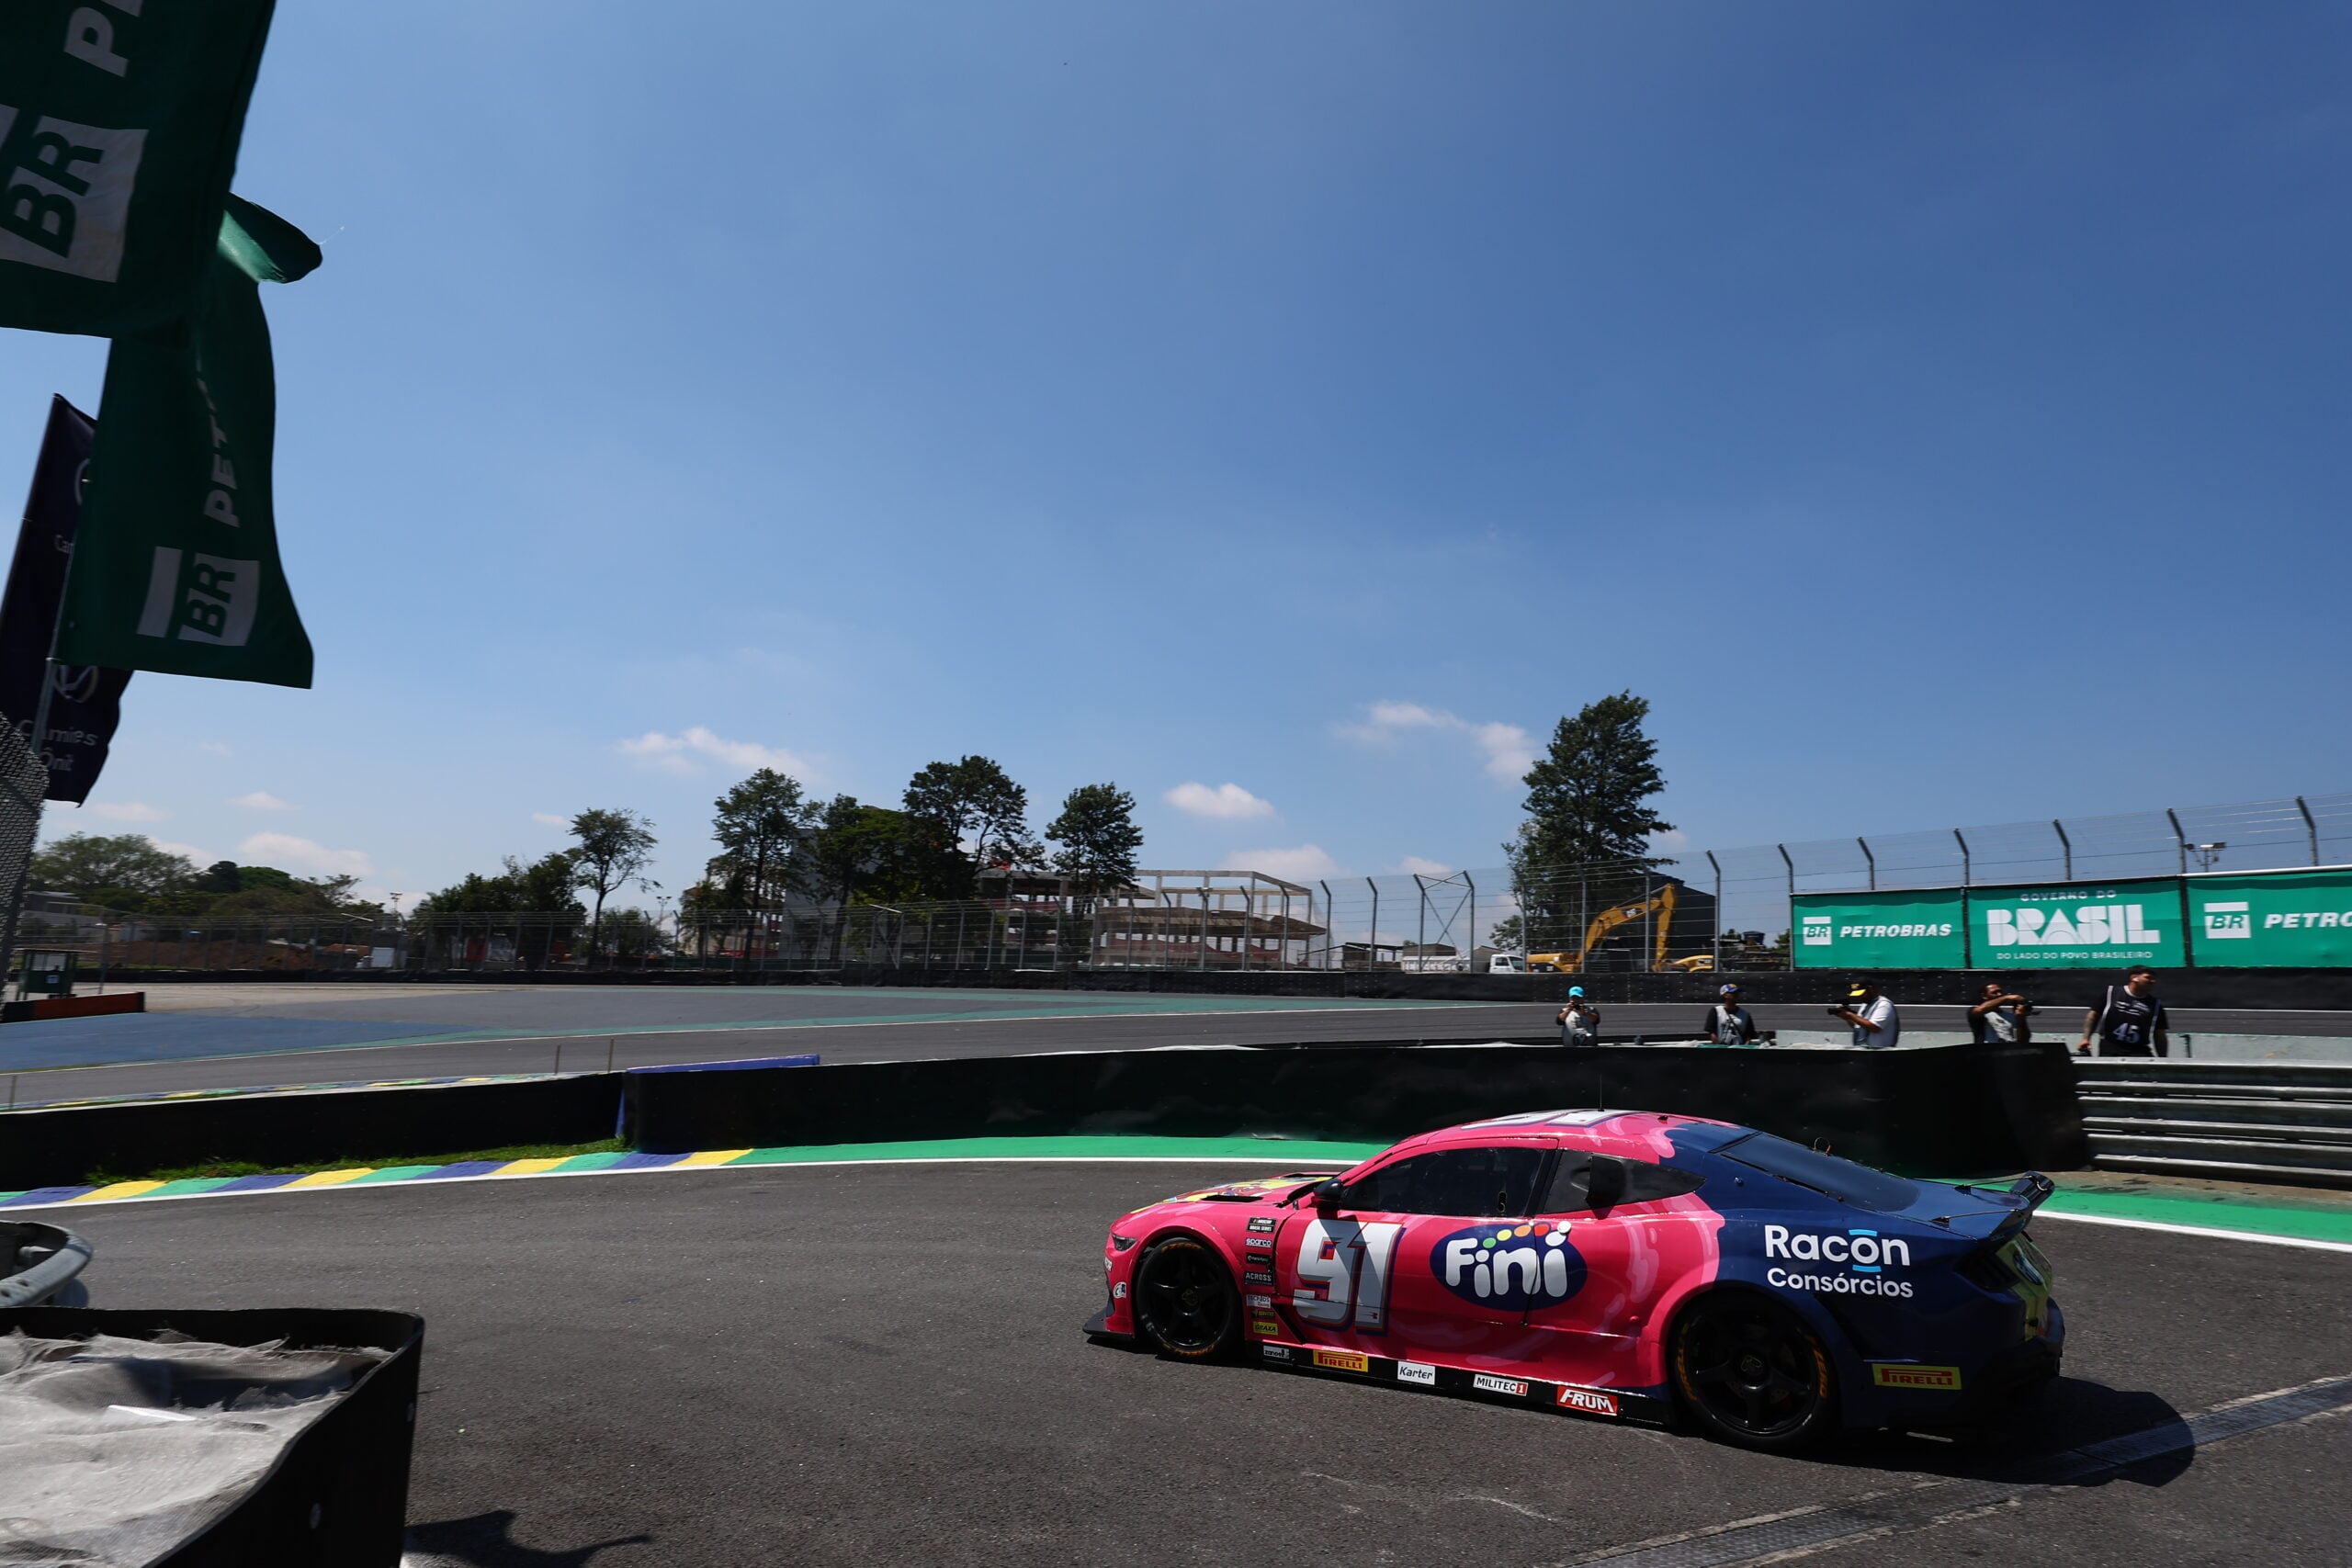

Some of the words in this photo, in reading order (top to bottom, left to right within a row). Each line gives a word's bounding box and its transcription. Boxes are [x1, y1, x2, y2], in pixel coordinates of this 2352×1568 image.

[3, 130, 104, 259] BR
[62, 0, 143, 78] P
[187, 561, 237, 639] BR
[2019, 890, 2089, 902] GOVERNO
[2096, 889, 2117, 899] DO
[1805, 926, 1828, 939] BR
[1839, 923, 1953, 938] PETROBRAS
[1986, 904, 2161, 946] BRASIL
[2210, 914, 2245, 930] BR
[2014, 952, 2041, 960] LADO
[2042, 952, 2058, 960] DO
[2061, 952, 2089, 960] POVO
[2092, 951, 2154, 960] BRASILEIRO
[2112, 1022, 2141, 1043] 45
[1445, 1229, 1568, 1298] Fini
[1245, 1272, 1272, 1282] ACROSS
[1292, 1218, 1406, 1335] 91
[1767, 1267, 1914, 1299] Consórcios
[1255, 1324, 1276, 1333] GRAXA
[1317, 1351, 1363, 1370] PIRELLI
[1399, 1366, 1433, 1380] Karter
[1881, 1368, 1953, 1386] PIRELLI
[1476, 1376, 1516, 1392] MILITEC
[1559, 1388, 1615, 1413] FRUM
